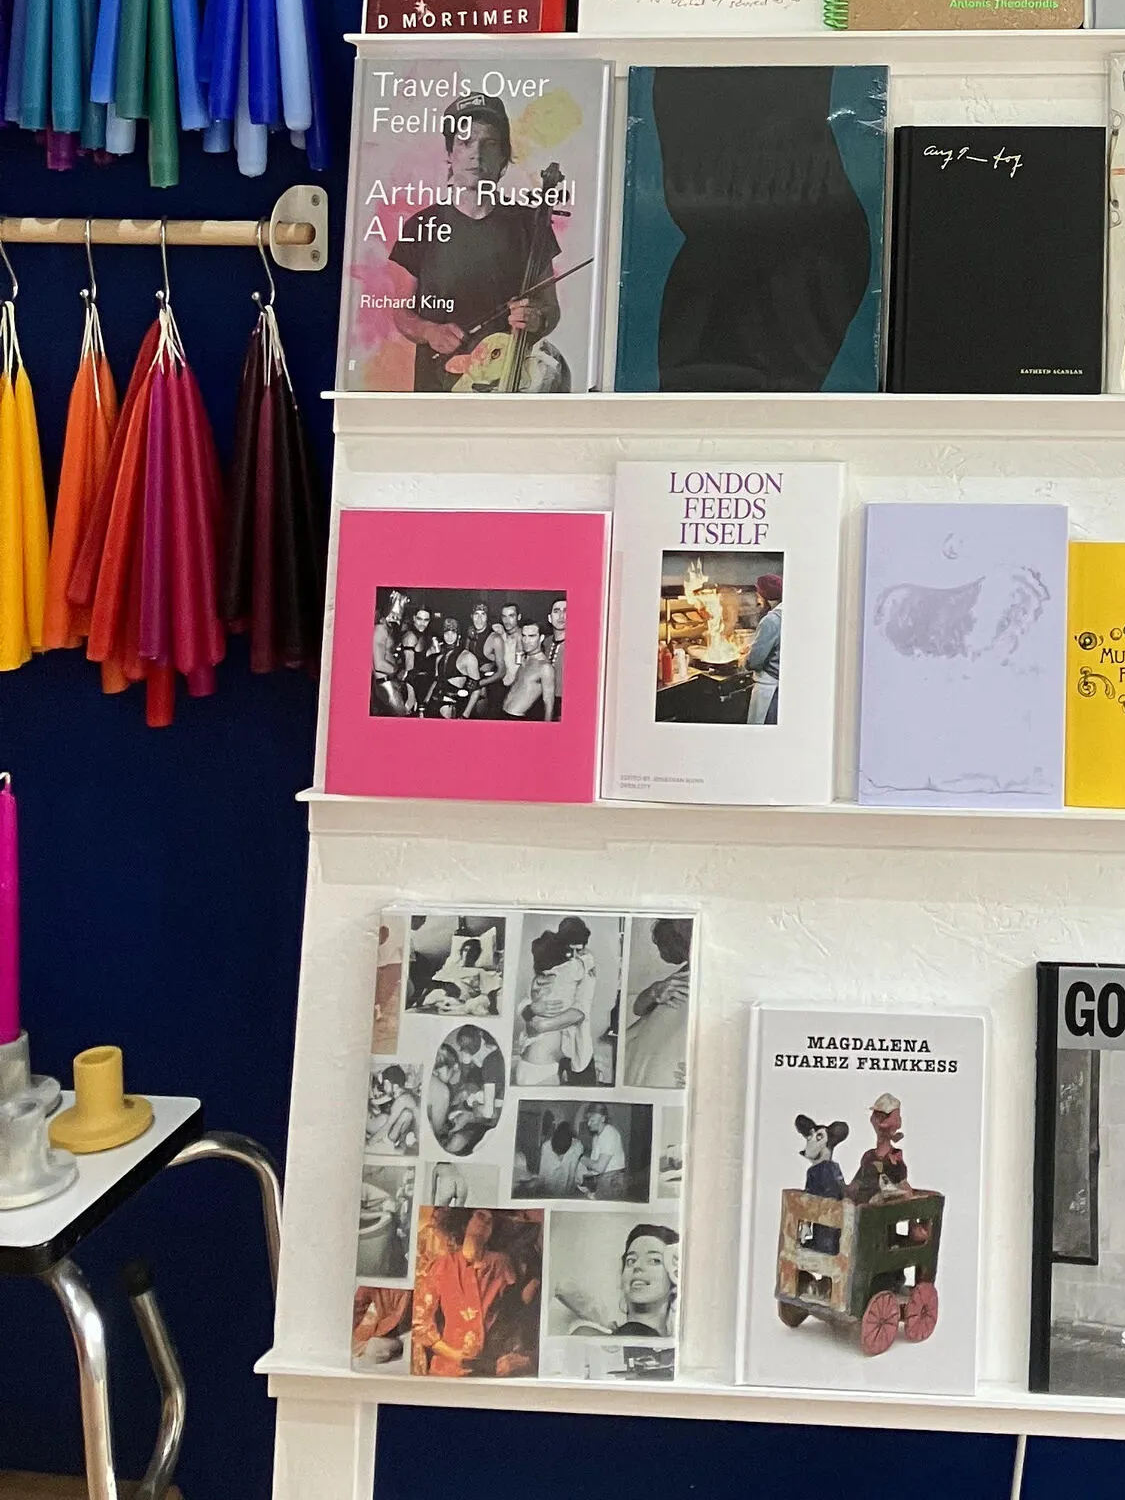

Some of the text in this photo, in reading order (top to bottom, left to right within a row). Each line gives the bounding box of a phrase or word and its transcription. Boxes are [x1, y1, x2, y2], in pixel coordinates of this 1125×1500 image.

[949, 0, 1059, 9] Antonis Theodoridis
[378, 8, 529, 29] D MORTIMER
[372, 72, 550, 99] Travels Over
[372, 107, 473, 141] Feeling
[364, 180, 577, 208] Arthur Russell
[363, 216, 452, 243] A Life
[360, 295, 454, 312] Richard King
[668, 472, 784, 495] LONDON
[684, 497, 767, 520] FEEDS
[679, 522, 770, 546] ITSELF
[807, 1036, 931, 1053] MAGDALENA
[774, 1054, 958, 1073] SUAREZ FRIMKESS
